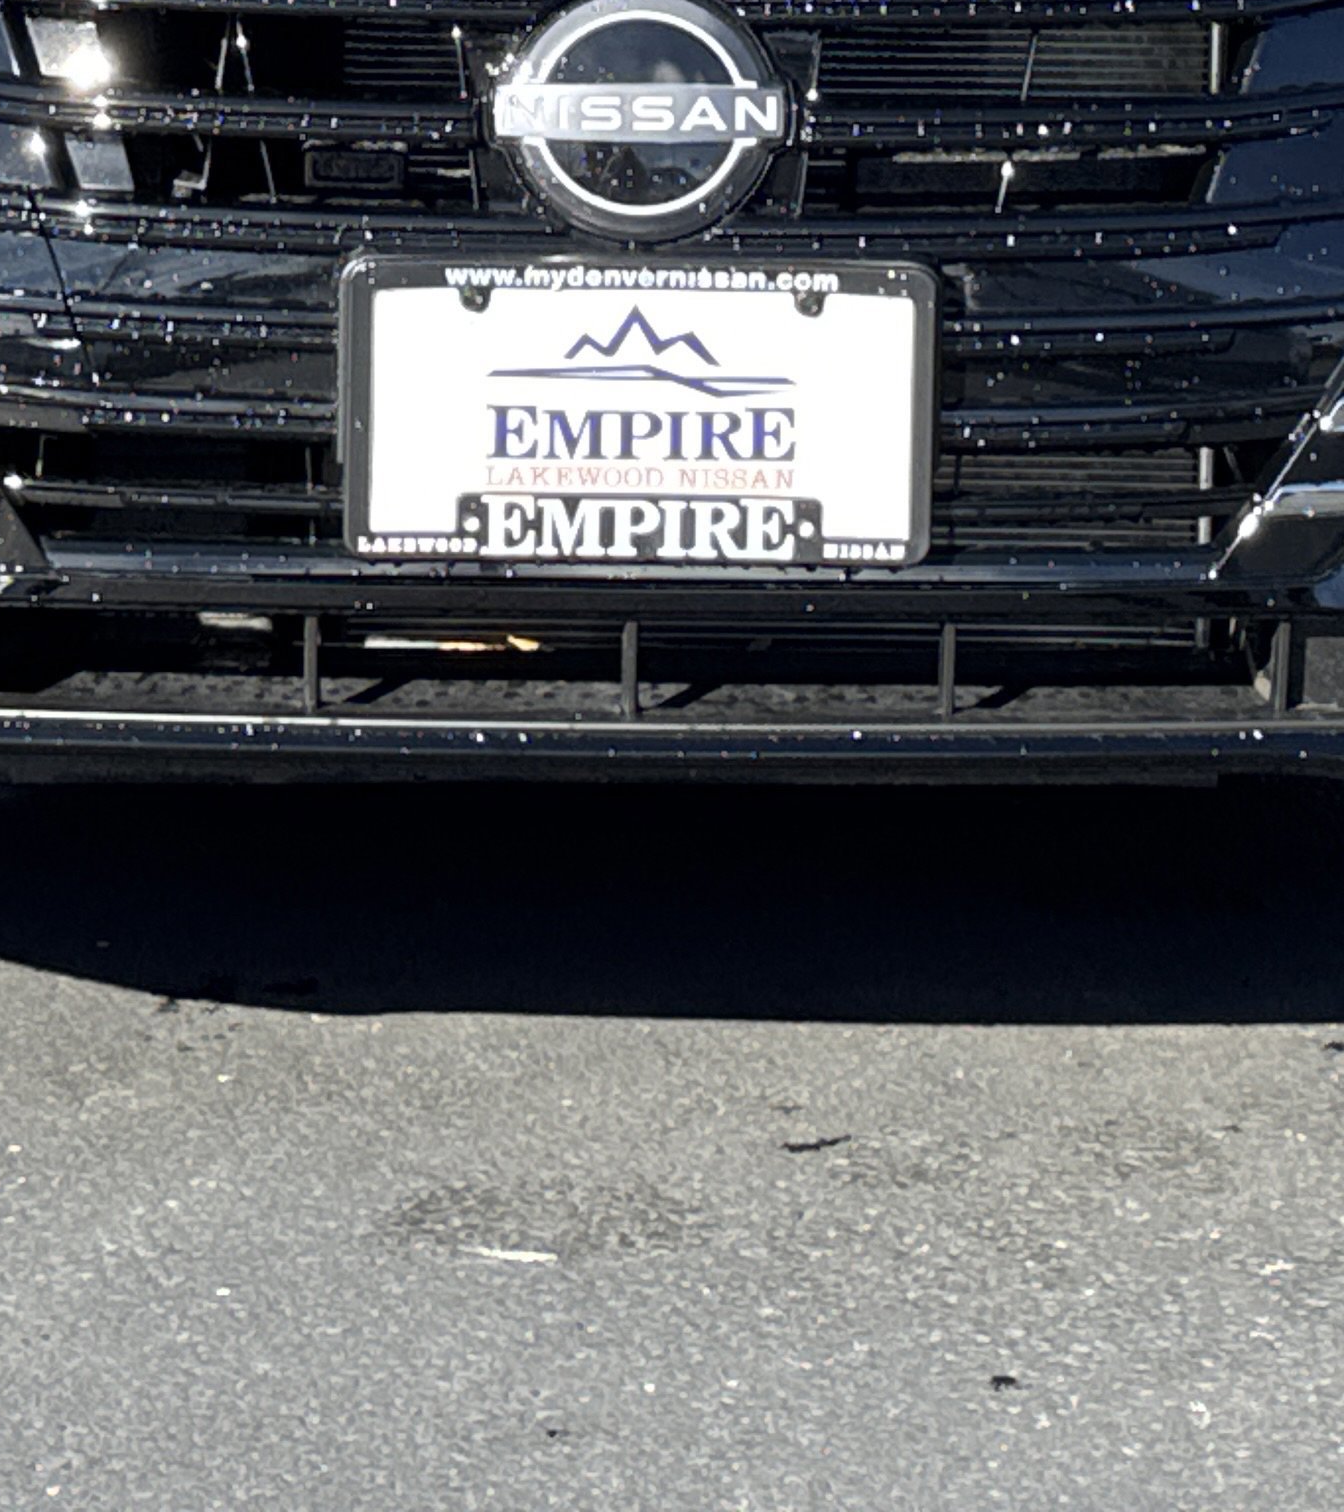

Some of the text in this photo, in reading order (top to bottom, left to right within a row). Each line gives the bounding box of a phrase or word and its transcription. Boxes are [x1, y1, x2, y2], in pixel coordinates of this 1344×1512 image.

[502, 94, 778, 132] NISSAN
[445, 265, 839, 292] www.mydenvernissan.com
[487, 404, 796, 461] EMPIRE
[486, 465, 796, 489] LAKEWOOD NISSAN
[480, 494, 794, 561] EMPIRE
